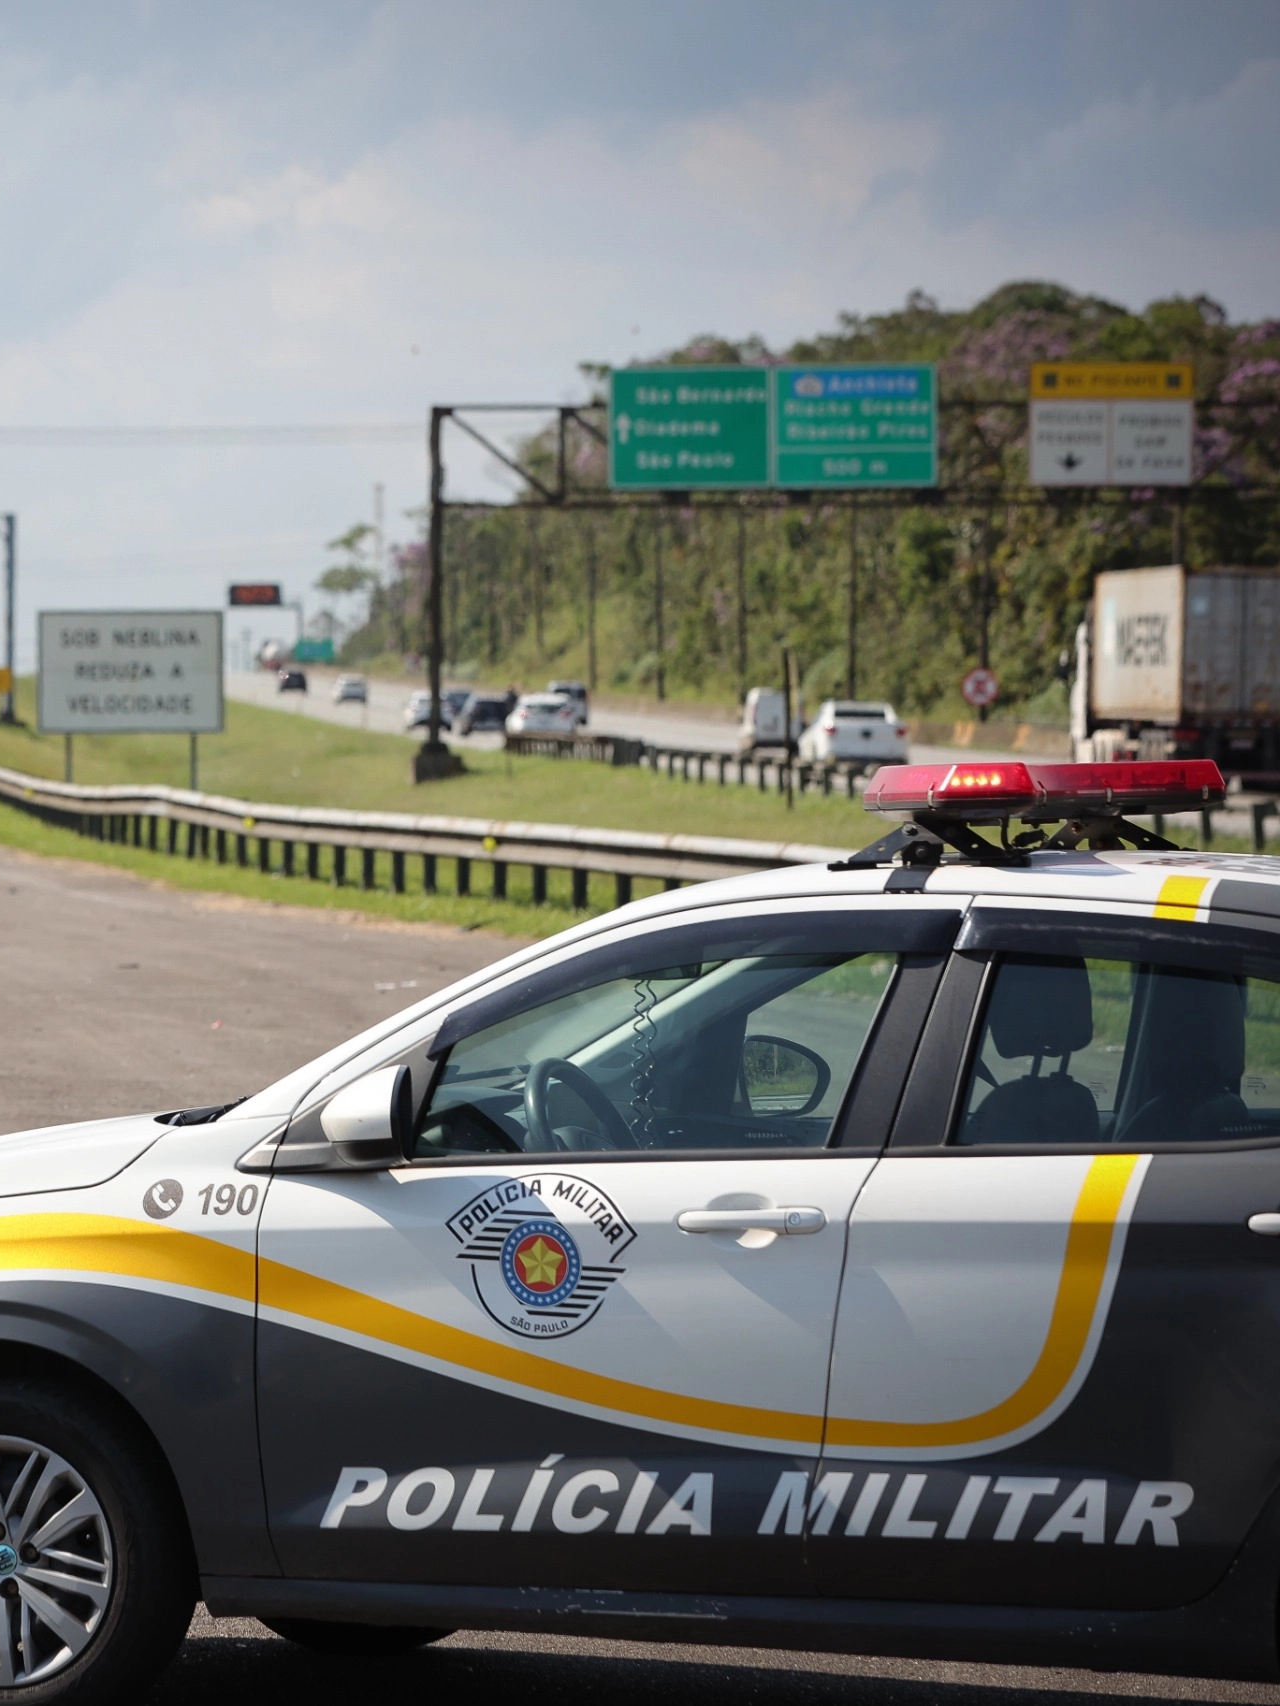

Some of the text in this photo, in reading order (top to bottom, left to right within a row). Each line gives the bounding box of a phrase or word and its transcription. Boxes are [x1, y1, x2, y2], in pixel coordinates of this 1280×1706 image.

[635, 386, 768, 404] São Bernardo
[635, 420, 720, 436] Diadema
[635, 452, 734, 469] São Paulo
[823, 459, 887, 475] 500 m
[59, 629, 199, 647] SOB NEBLINA
[75, 663, 185, 681] REDUZA A
[67, 695, 194, 714] VELOCIDADE
[198, 1183, 259, 1216] 190
[458, 1179, 624, 1245] POLÍCIA MILITAR
[510, 1315, 569, 1334] SÃO PAULO
[320, 1453, 1196, 1548] POLÍCIA MILITAR
